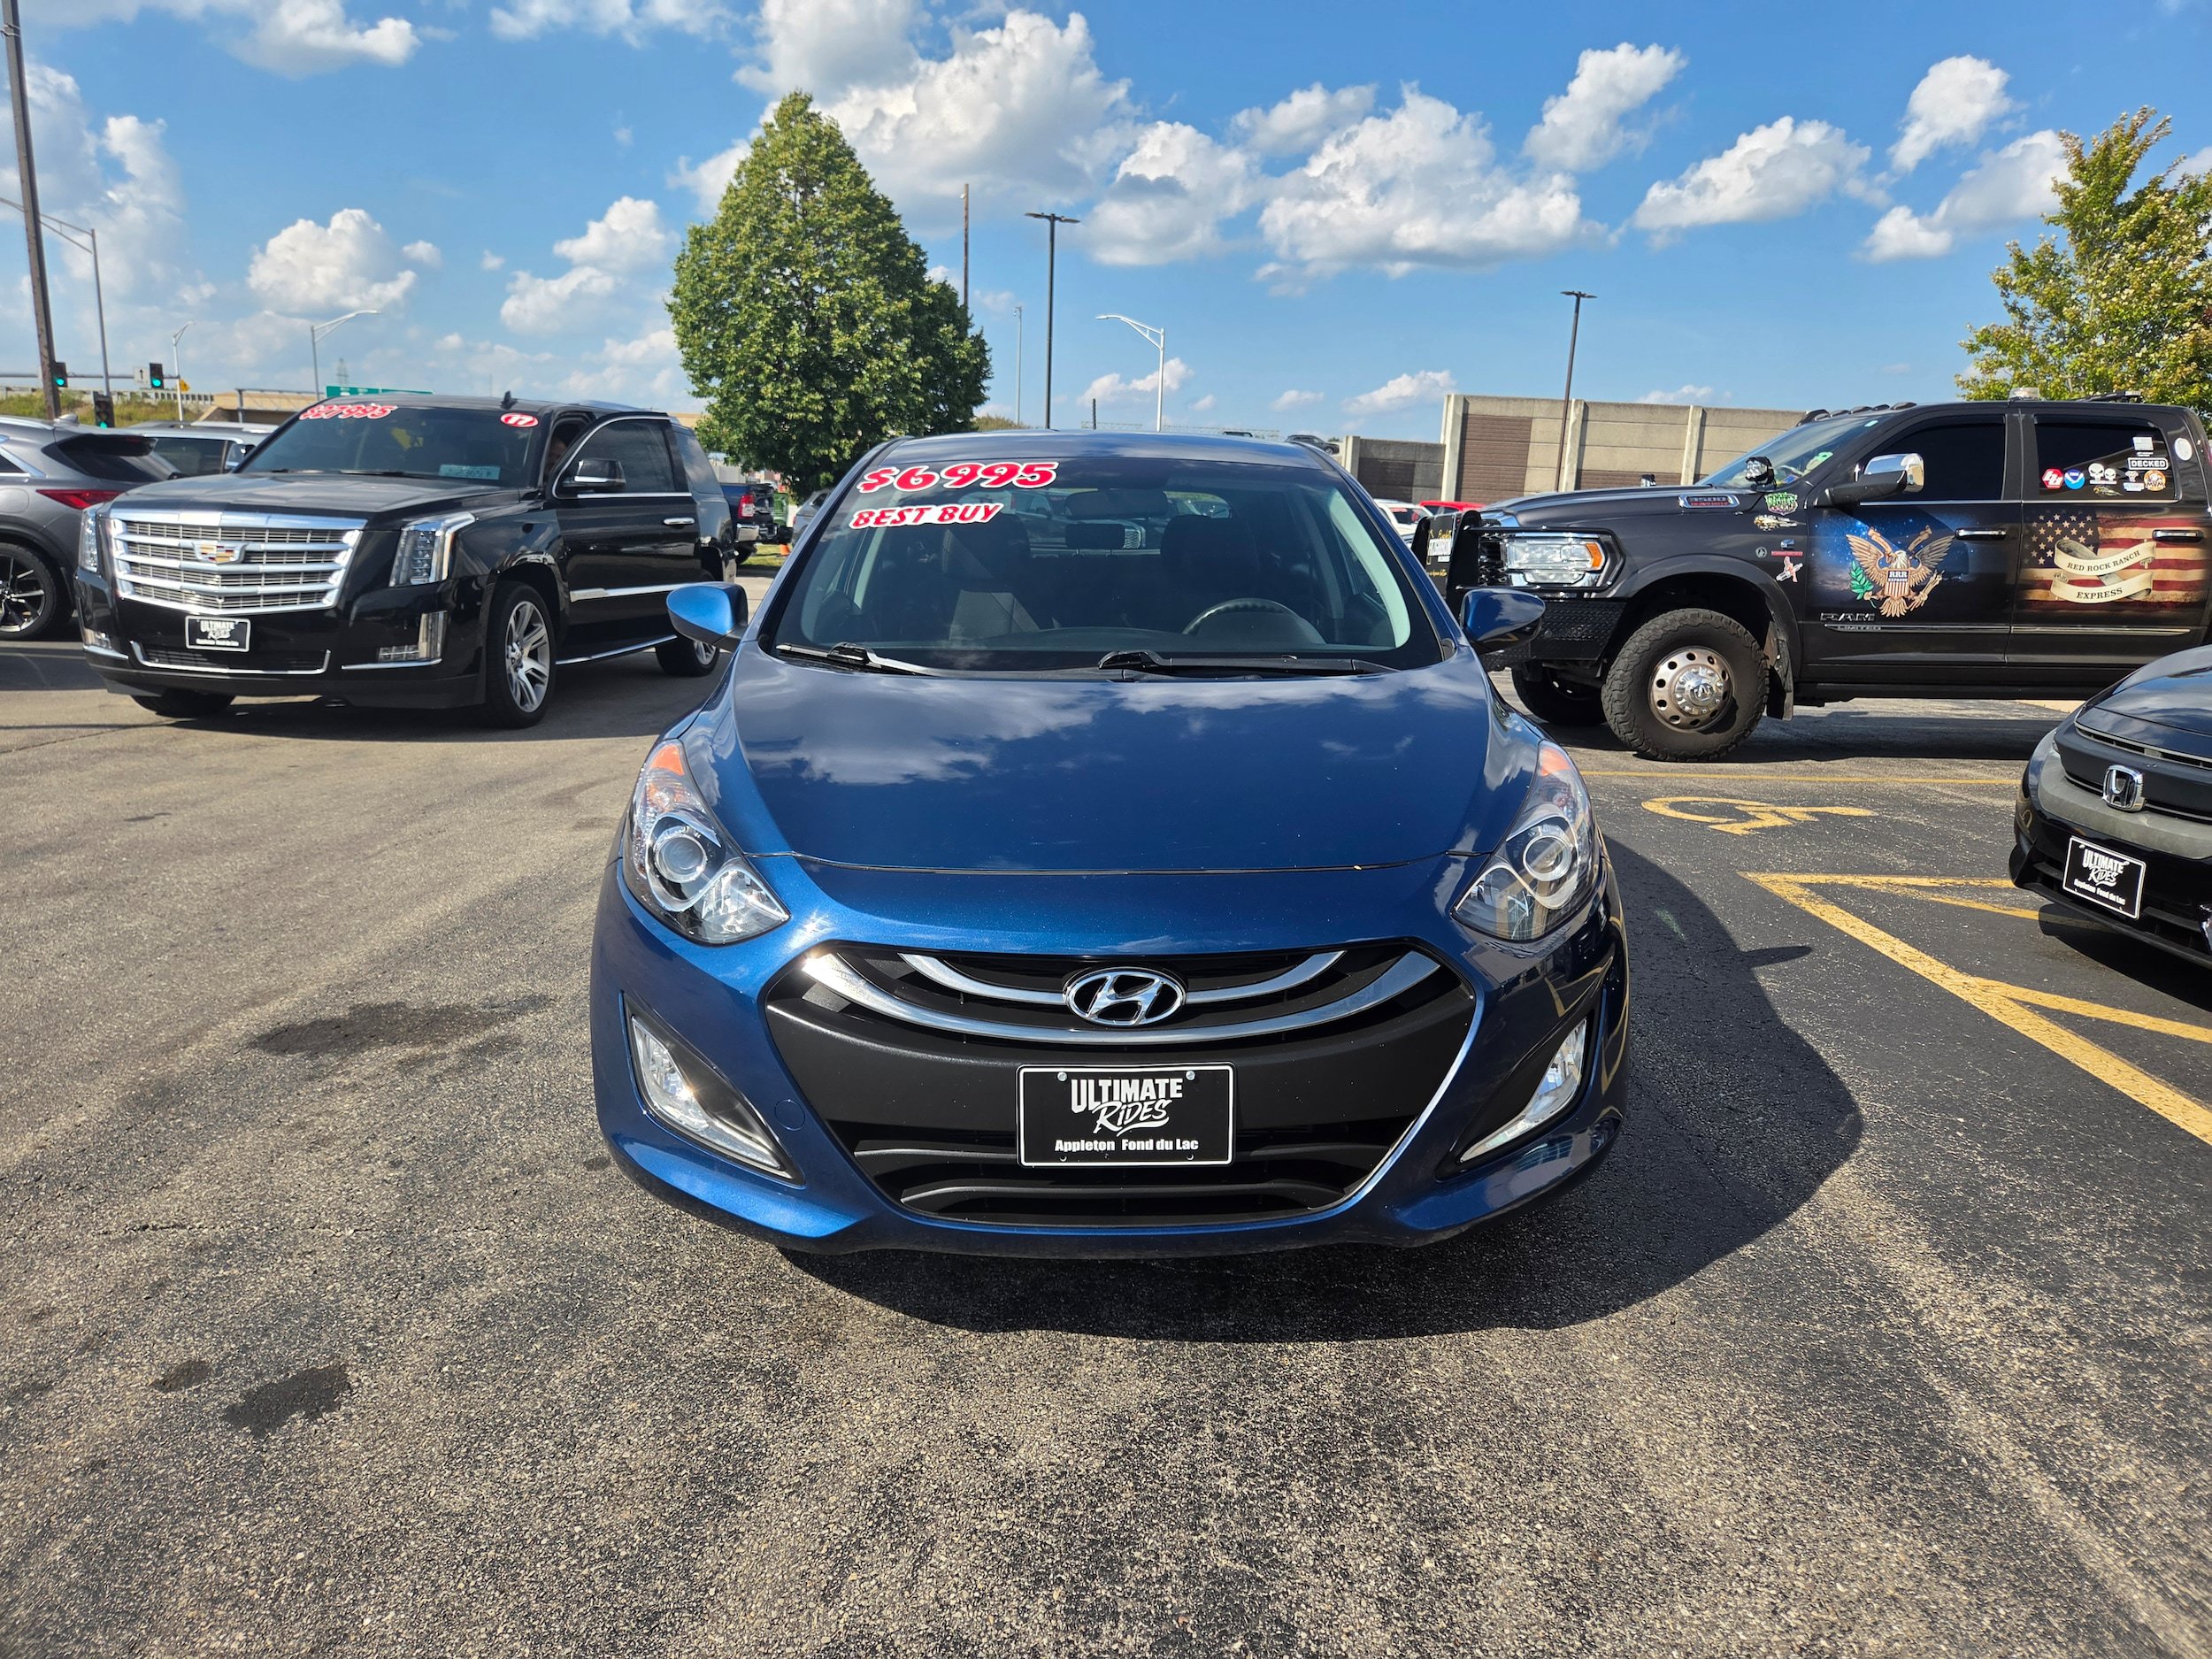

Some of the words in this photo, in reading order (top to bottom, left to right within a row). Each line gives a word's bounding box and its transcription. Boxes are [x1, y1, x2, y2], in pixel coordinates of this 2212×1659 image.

[505, 414, 532, 426] 17
[858, 463, 1058, 492] $6995
[851, 508, 933, 528] BEST
[936, 504, 1002, 523] BUY
[2067, 562, 2085, 572] RED
[2087, 563, 2111, 572] ROCK
[2113, 549, 2140, 566] RANCH
[2077, 588, 2123, 600] EXPRESS
[200, 619, 235, 633] ULTIMATE
[1820, 612, 1875, 622] RAM
[2082, 849, 2124, 874] ULTIMATE
[1071, 1078, 1183, 1114] ULTIMATE
[1055, 1138, 1115, 1152] Appleton
[1121, 1138, 1154, 1151] Fond
[1156, 1138, 1173, 1151] du
[1175, 1138, 1199, 1150] Lac
